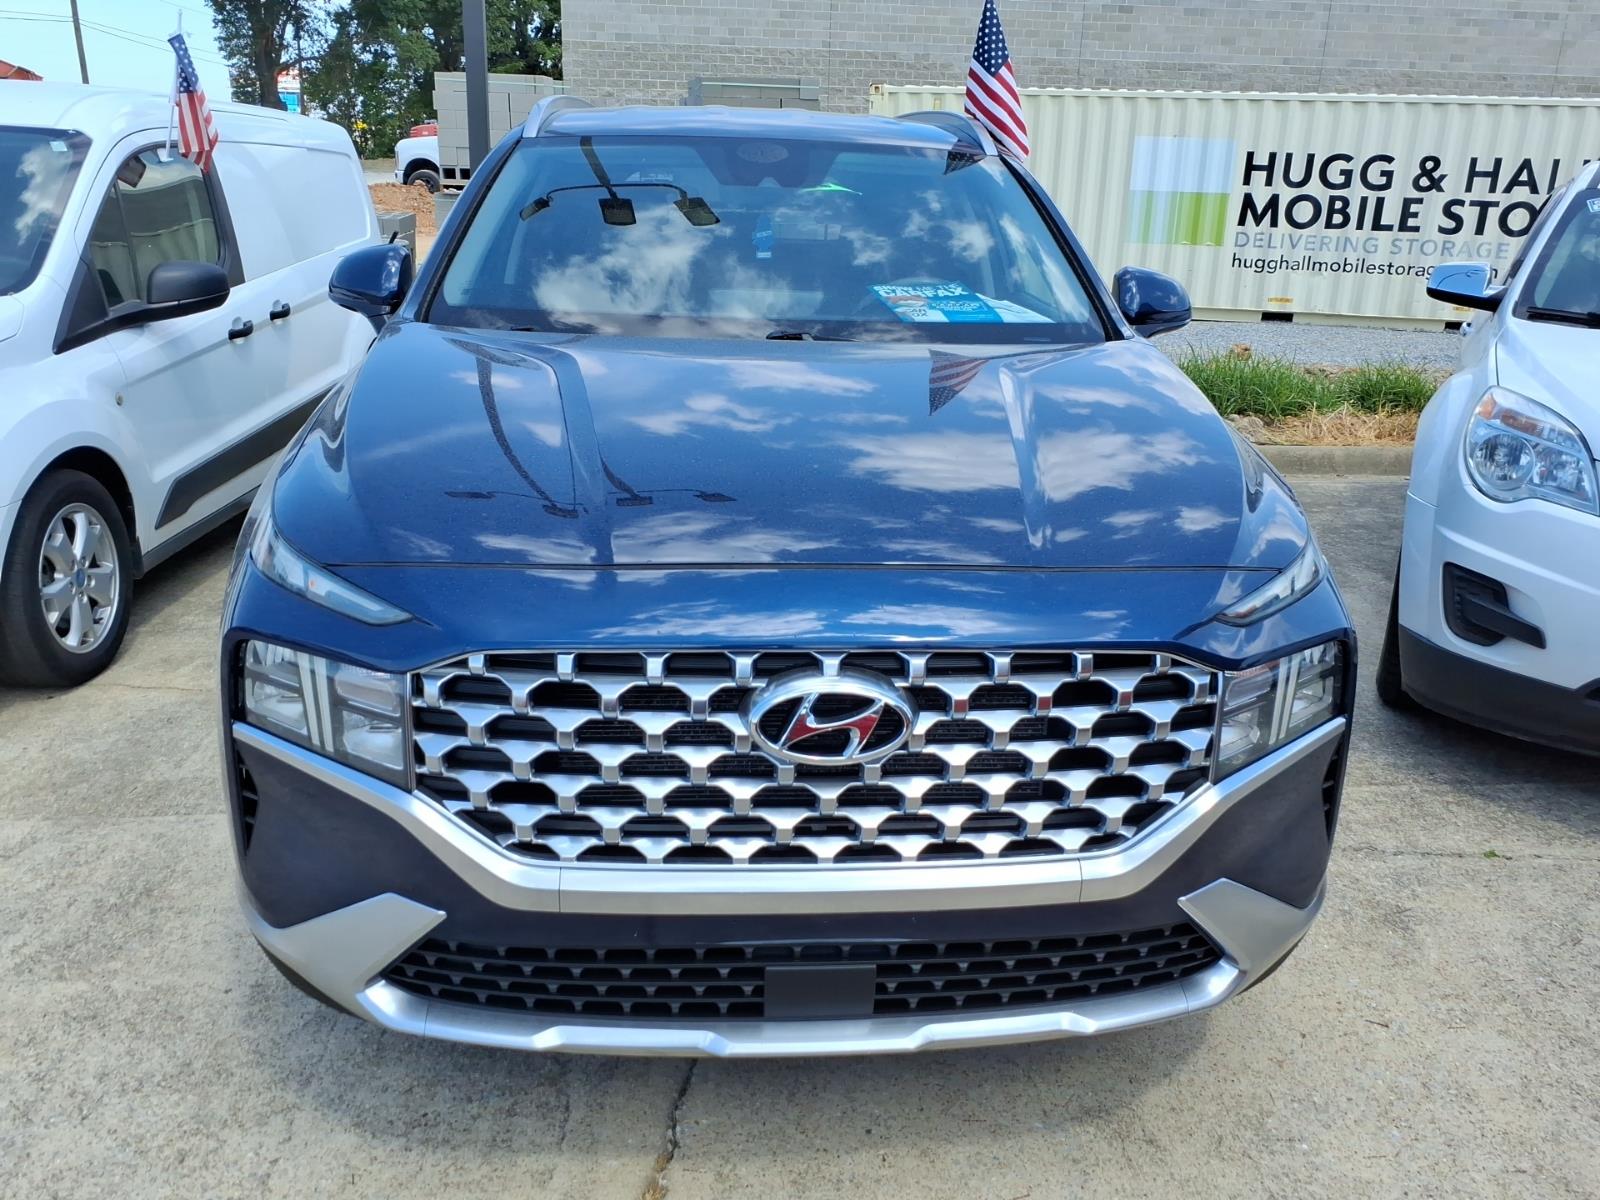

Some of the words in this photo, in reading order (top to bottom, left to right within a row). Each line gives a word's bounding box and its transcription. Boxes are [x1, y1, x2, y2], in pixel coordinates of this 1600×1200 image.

[1242, 150, 1396, 192] HUGG
[1411, 154, 1449, 194] &
[1464, 156, 1591, 196] HAL
[1236, 192, 1425, 233] MOBILE
[1234, 231, 1380, 255] DELIVERING
[1390, 238, 1510, 261] STORAGE
[878, 287, 969, 298] CARFAX
